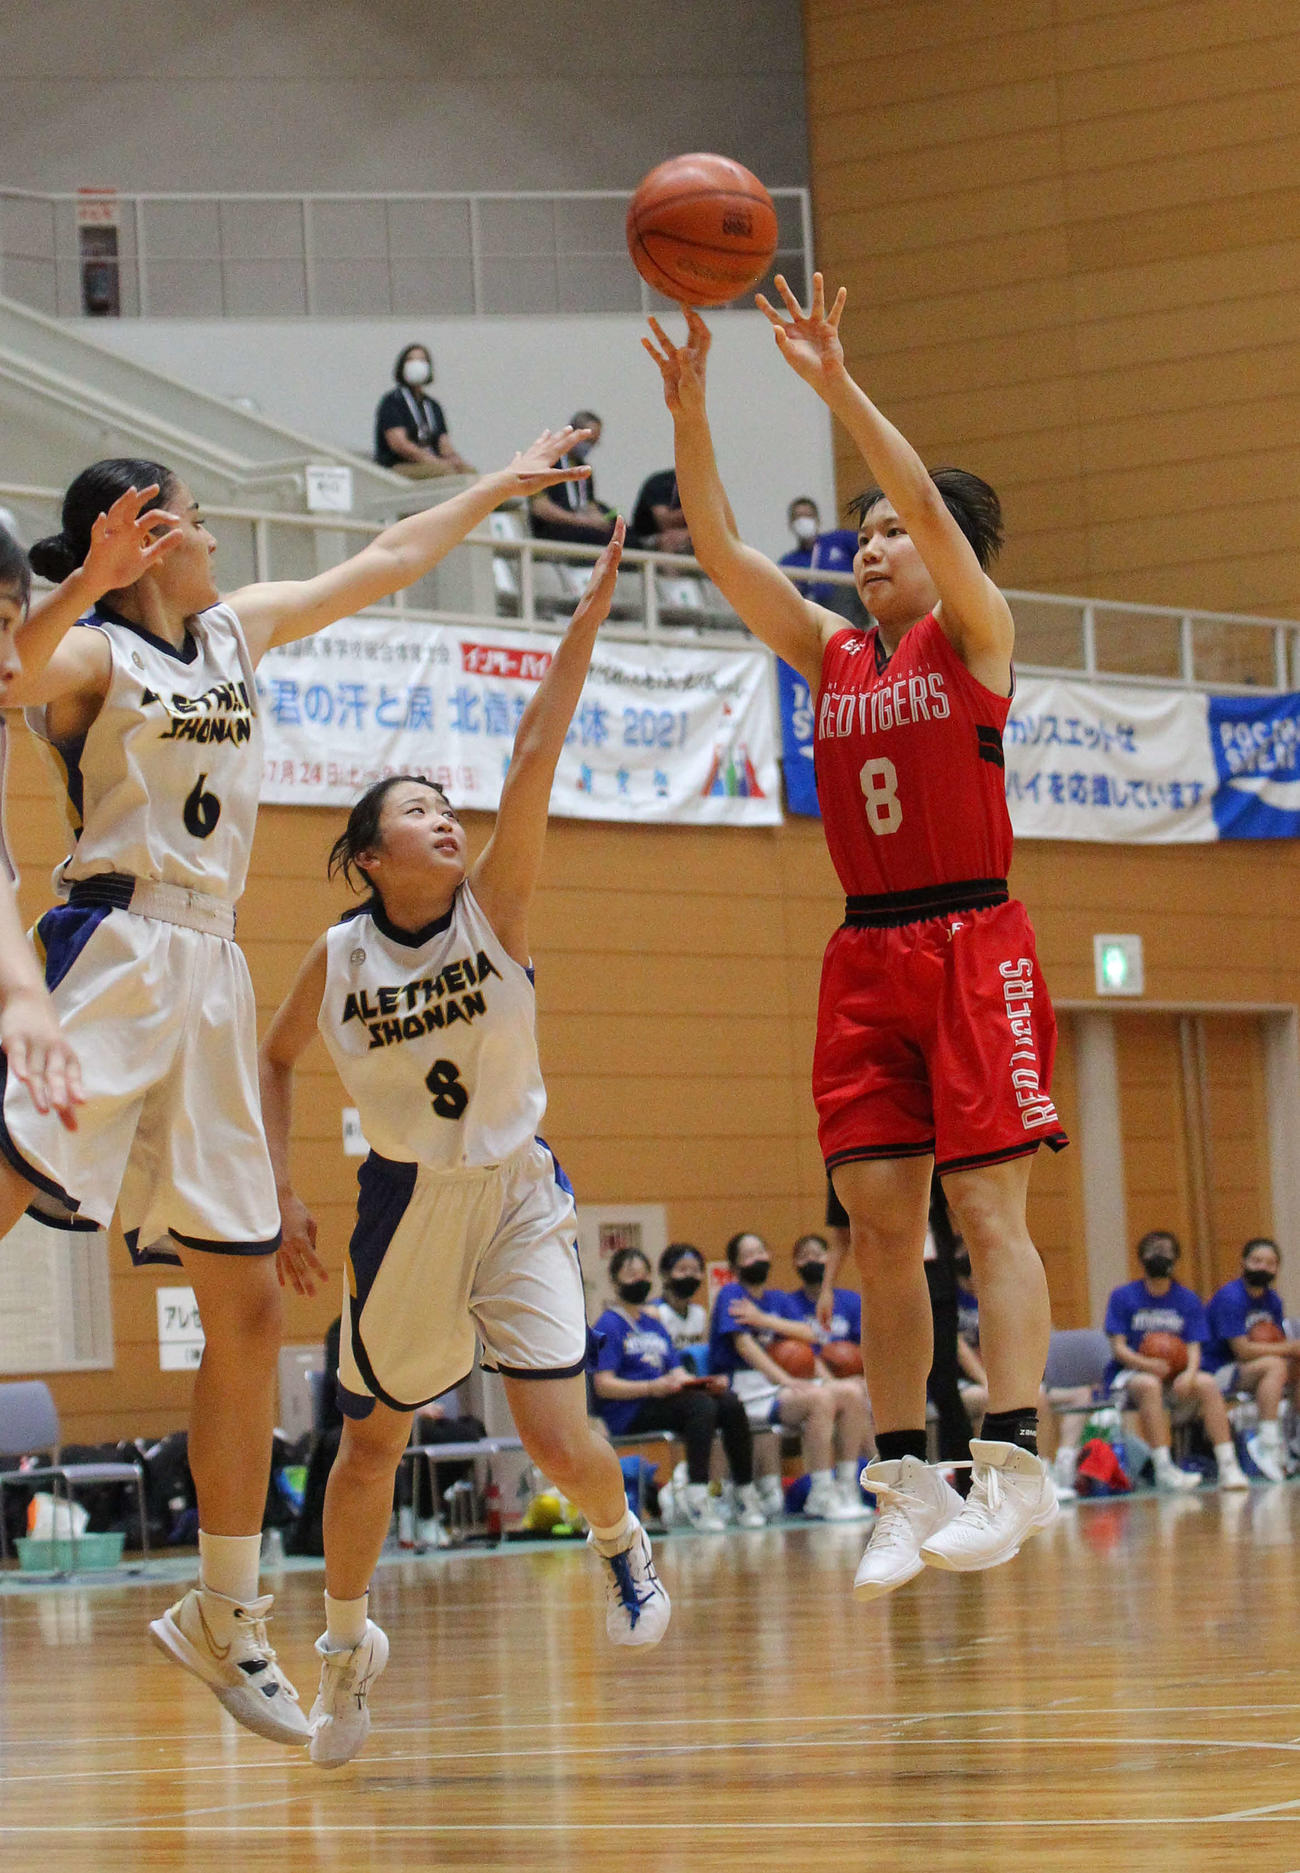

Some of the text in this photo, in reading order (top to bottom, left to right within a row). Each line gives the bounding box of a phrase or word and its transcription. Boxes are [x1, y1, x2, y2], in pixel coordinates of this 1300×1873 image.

[158, 717, 251, 748] SHONAN
[253, 678, 435, 731] 君の汗と涙
[623, 705, 687, 748] 2021
[183, 772, 221, 839] 6
[859, 756, 903, 836] 8
[341, 950, 503, 1026] ALETHEIA
[367, 990, 488, 1050] SHONAN
[424, 1058, 469, 1120] 8
